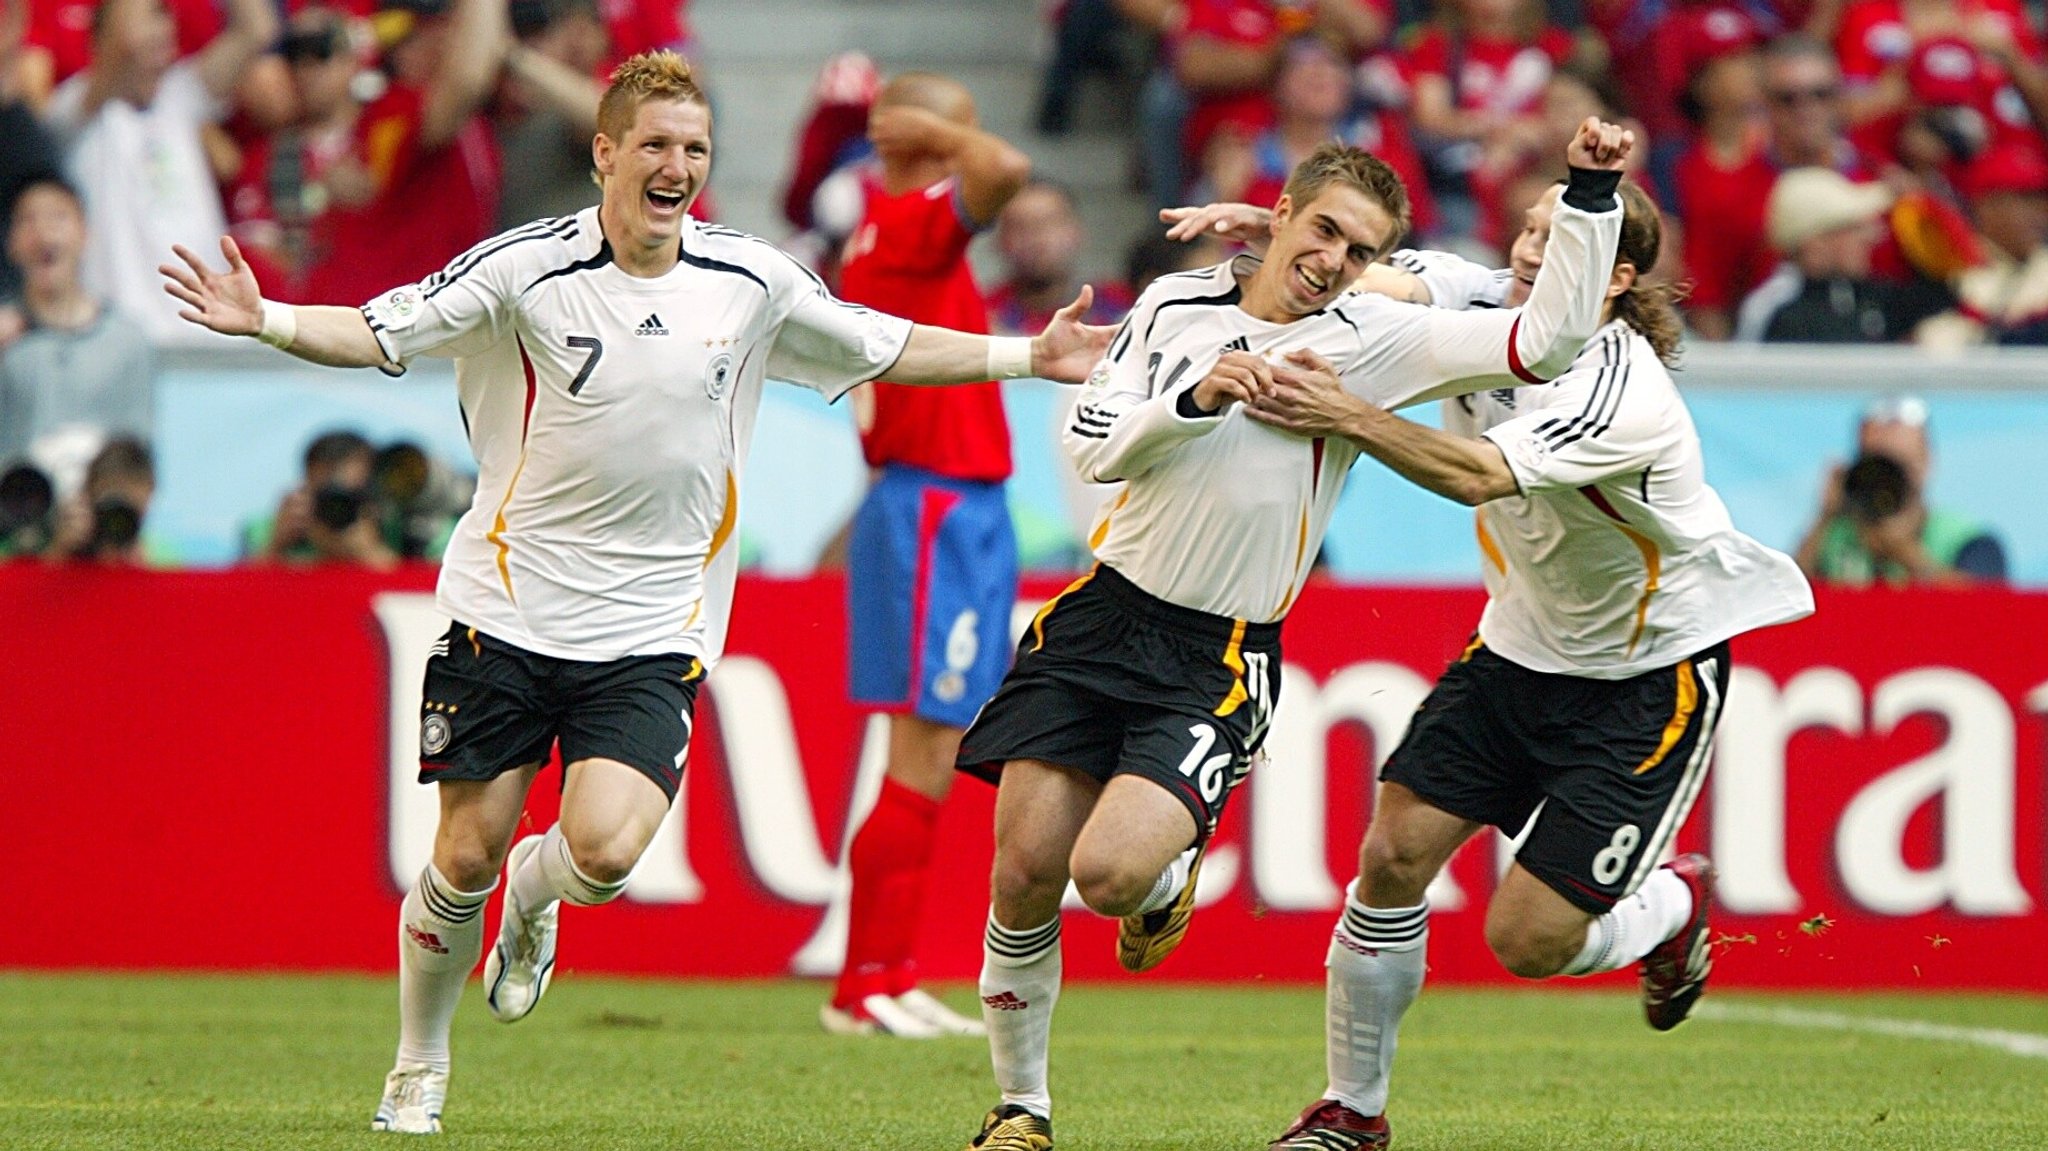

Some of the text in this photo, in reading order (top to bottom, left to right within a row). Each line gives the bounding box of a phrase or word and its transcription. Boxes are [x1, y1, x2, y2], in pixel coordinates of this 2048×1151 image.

[634, 327, 670, 336] adidas
[566, 336, 603, 397] 7
[946, 609, 979, 672] 6
[1177, 723, 1233, 804] 16
[1591, 823, 1642, 886] 8
